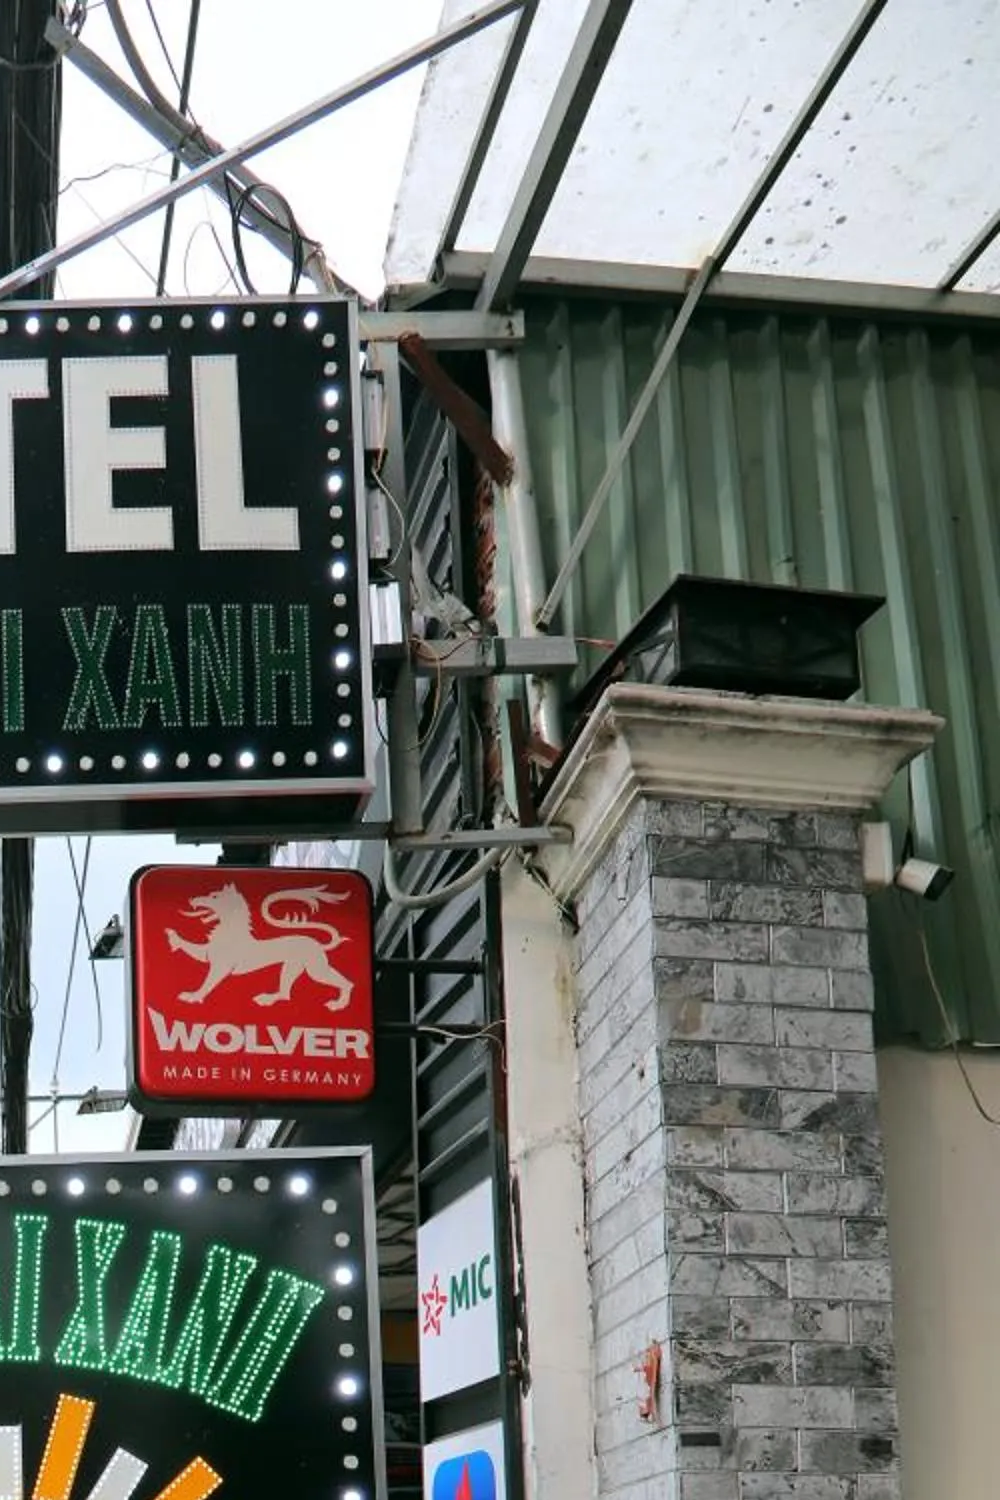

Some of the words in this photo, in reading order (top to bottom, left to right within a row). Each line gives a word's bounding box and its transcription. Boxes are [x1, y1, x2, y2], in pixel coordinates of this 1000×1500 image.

[60, 603, 313, 732] XANH
[147, 1006, 370, 1058] WOLVER
[163, 1066, 221, 1080] MADE
[231, 1067, 251, 1080] IN
[263, 1068, 362, 1086] GERMANY
[449, 1254, 493, 1318] MIC
[54, 1215, 326, 1424] XANH
